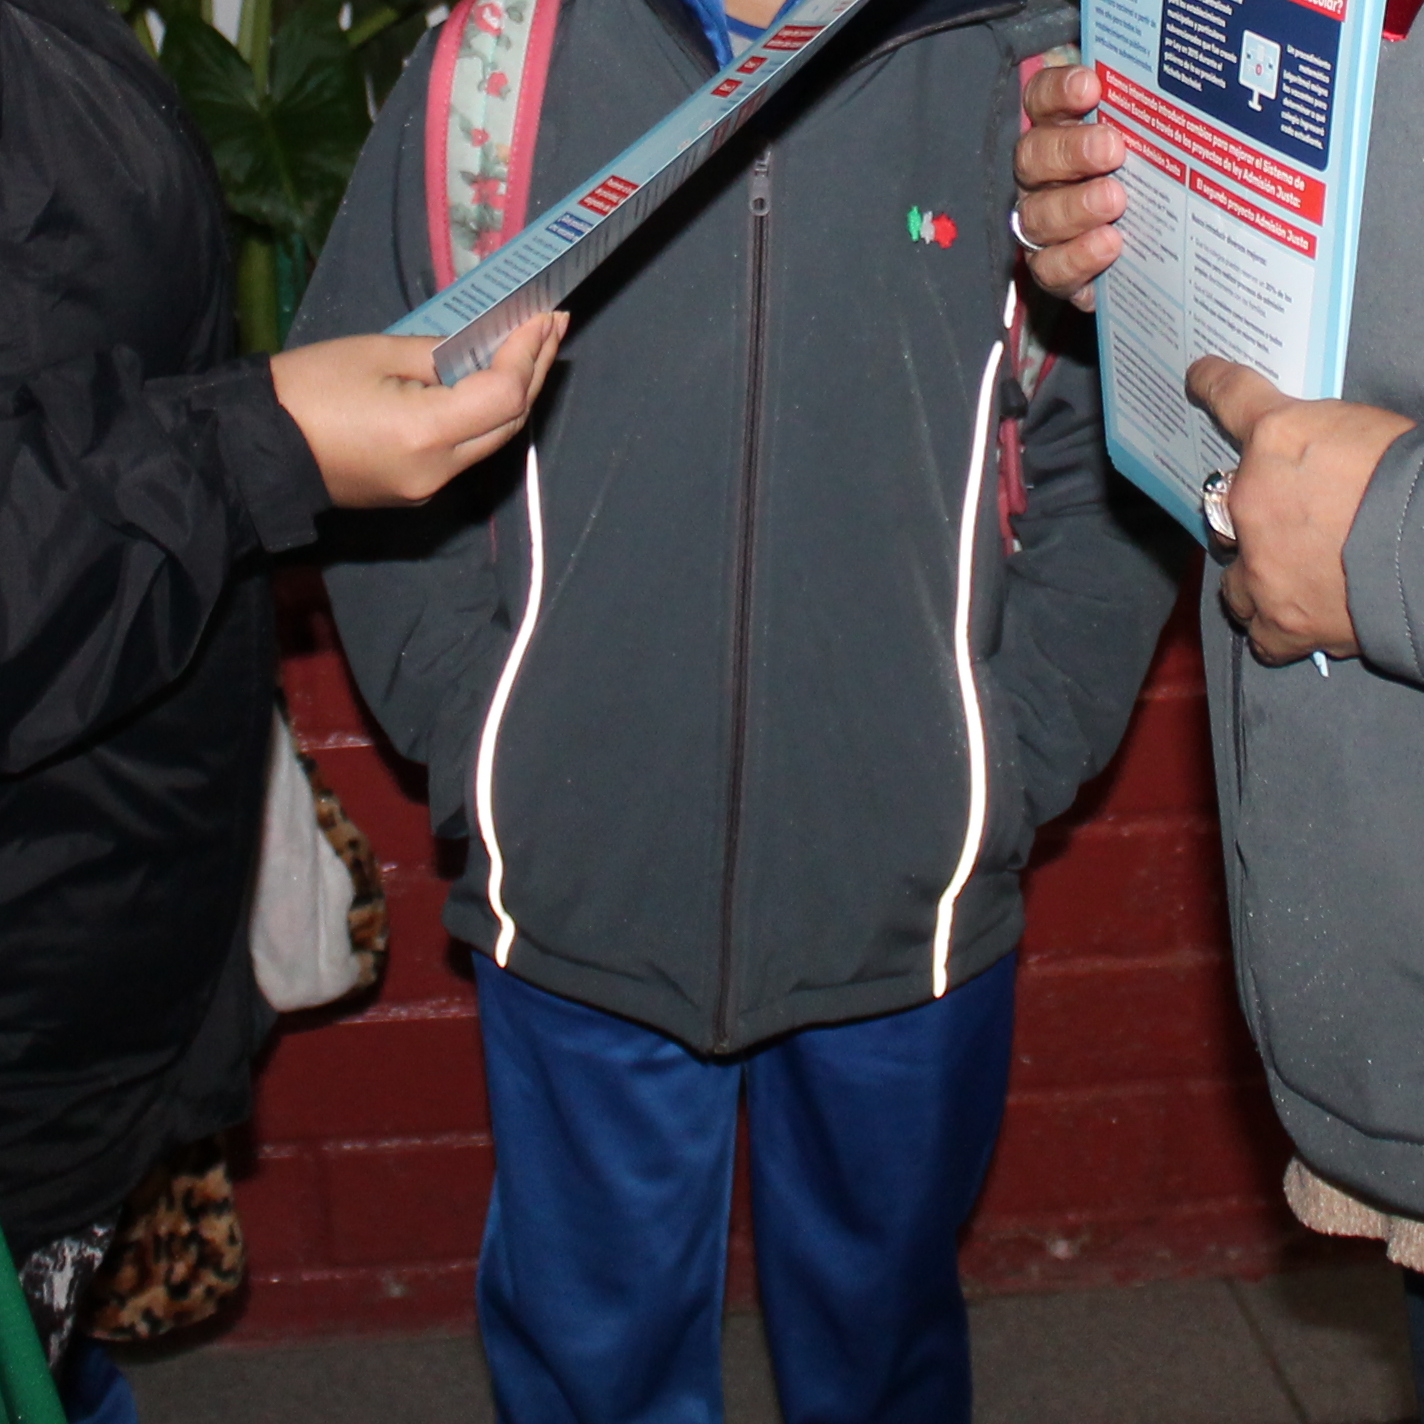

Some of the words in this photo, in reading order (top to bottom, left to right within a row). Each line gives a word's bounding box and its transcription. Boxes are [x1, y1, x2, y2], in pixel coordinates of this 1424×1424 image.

[1196, 177, 1203, 189] El
[1203, 184, 1227, 204] segundo
[1227, 199, 1254, 220] proyecto
[1255, 212, 1286, 238] Admisión
[1286, 230, 1309, 250] Justa
